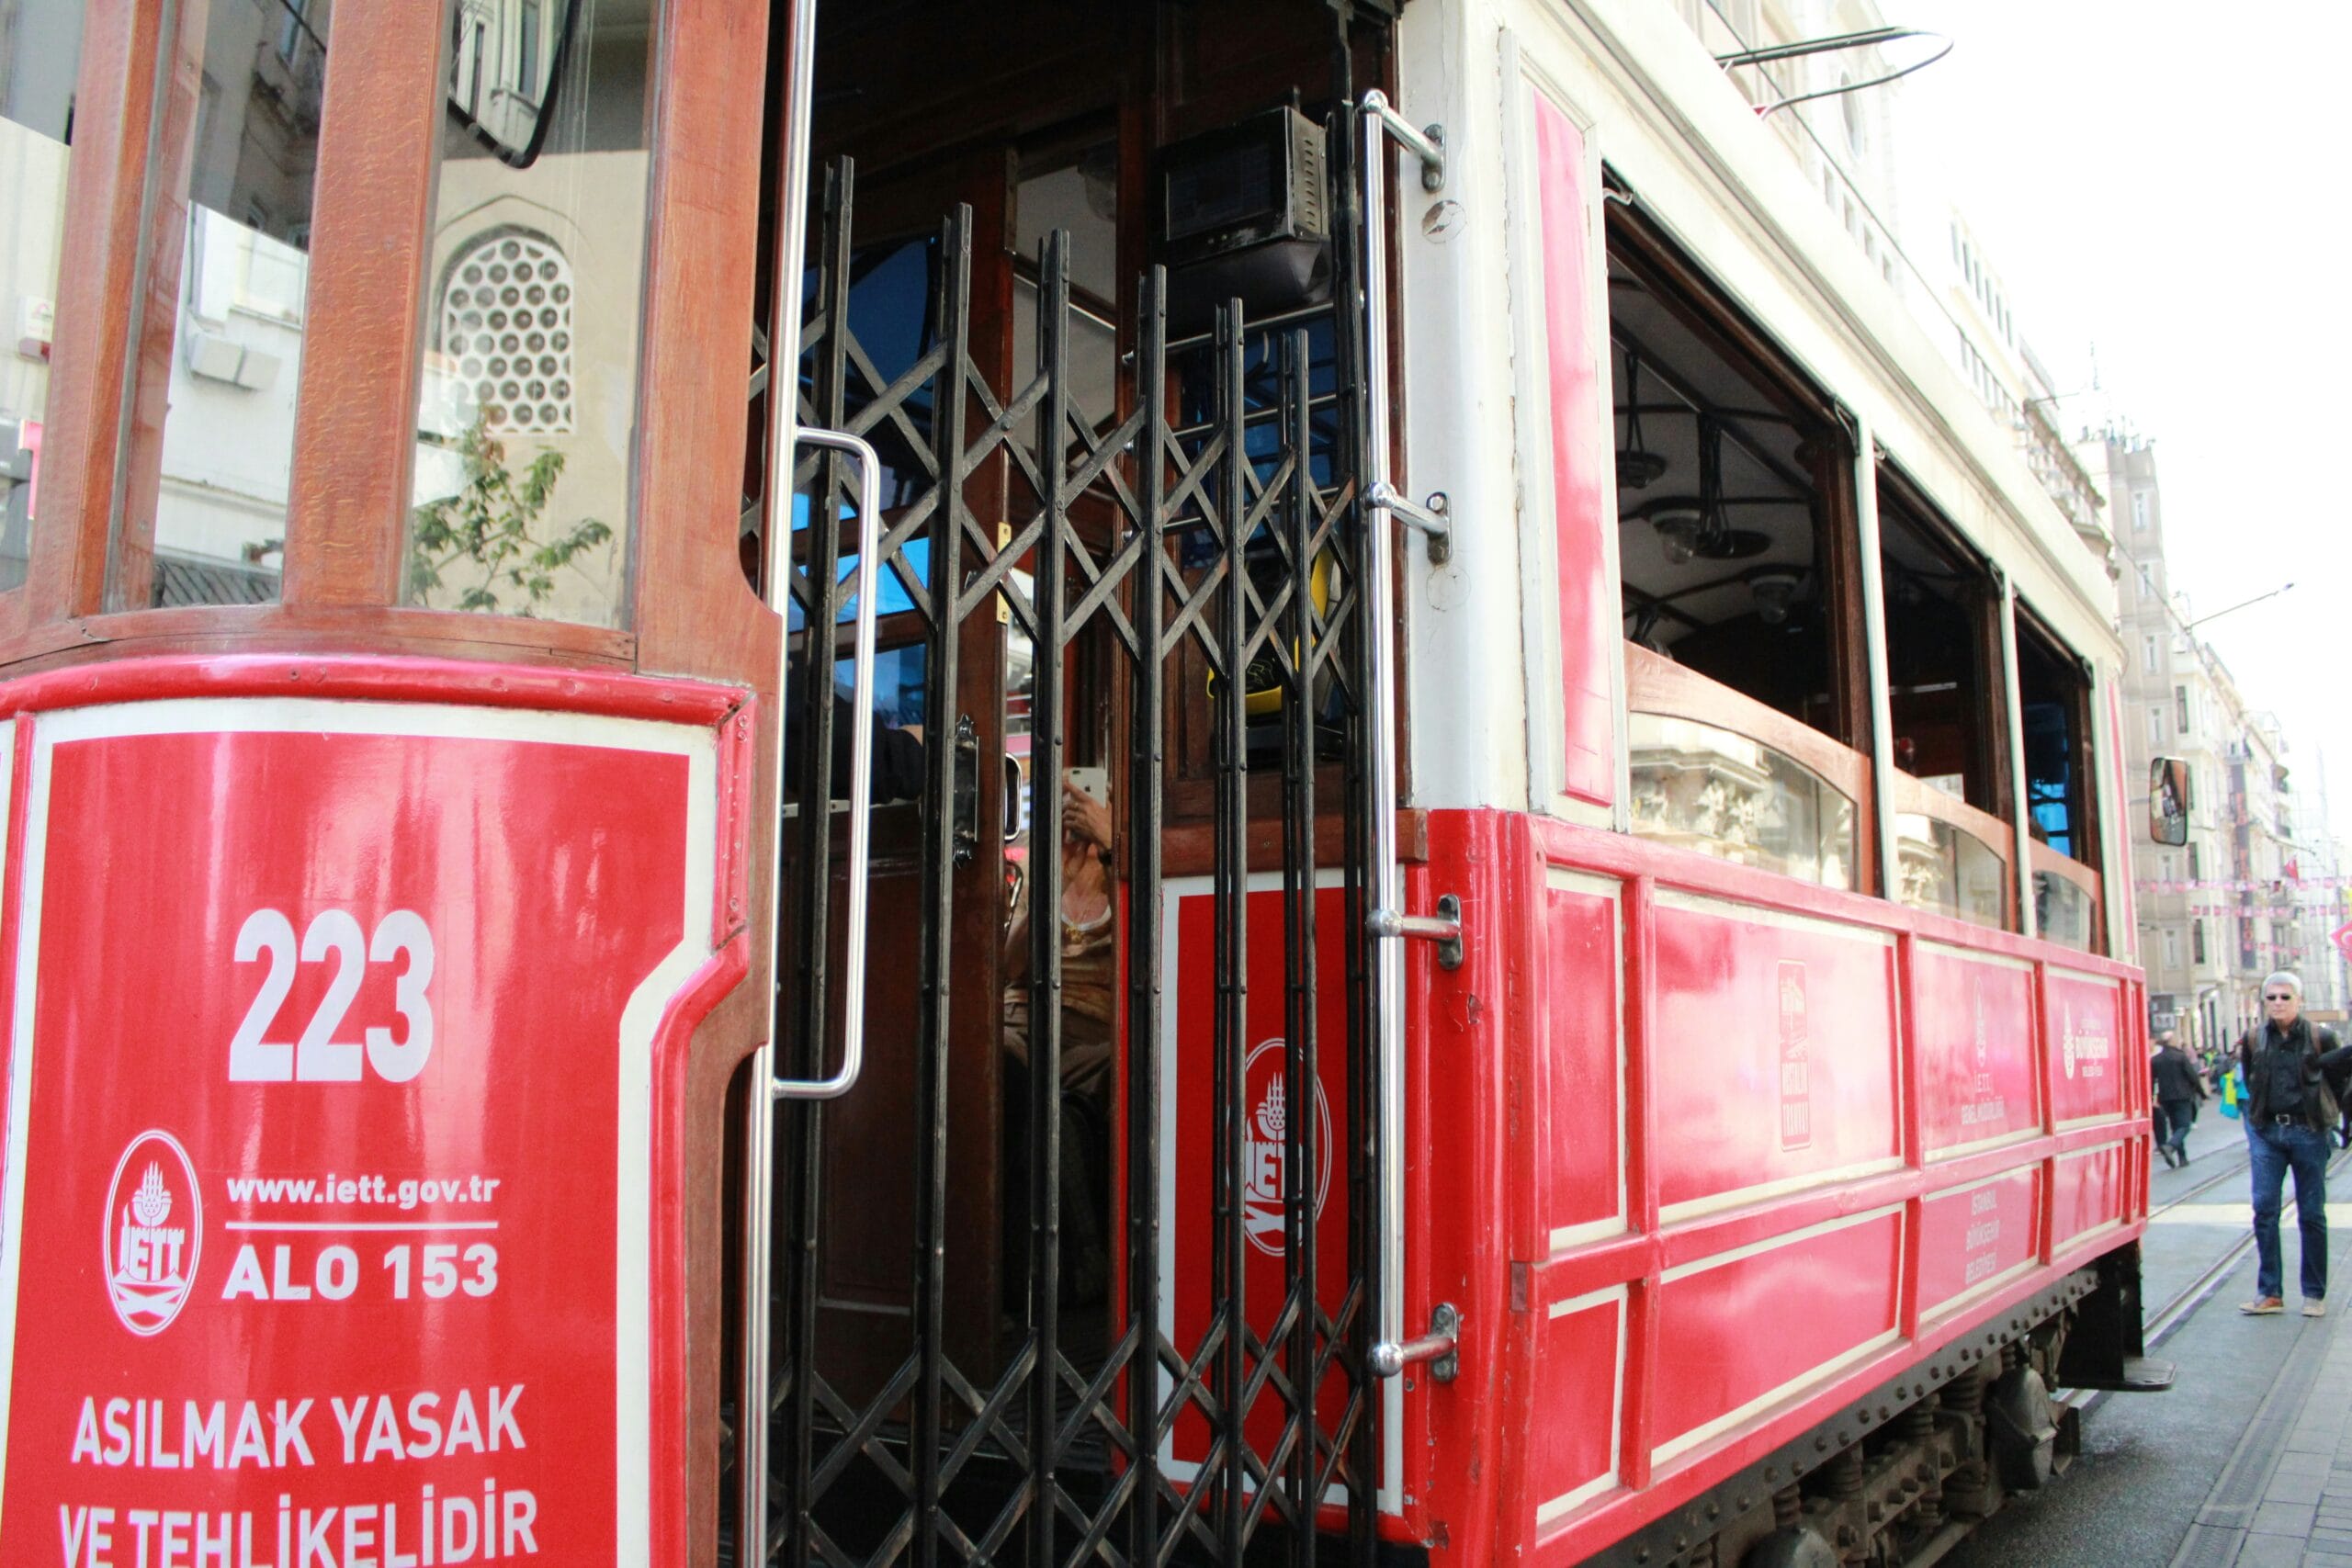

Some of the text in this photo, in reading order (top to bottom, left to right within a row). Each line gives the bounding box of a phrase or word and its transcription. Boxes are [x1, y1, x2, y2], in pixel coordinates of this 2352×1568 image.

[229, 908, 435, 1082] 223
[227, 1173, 500, 1210] www.iett.gov.tr
[221, 1243, 498, 1301] ALO 153
[72, 1384, 526, 1470] ASILMAK YASAK
[61, 1478, 538, 1568] VE TEHLİKELİDİR
